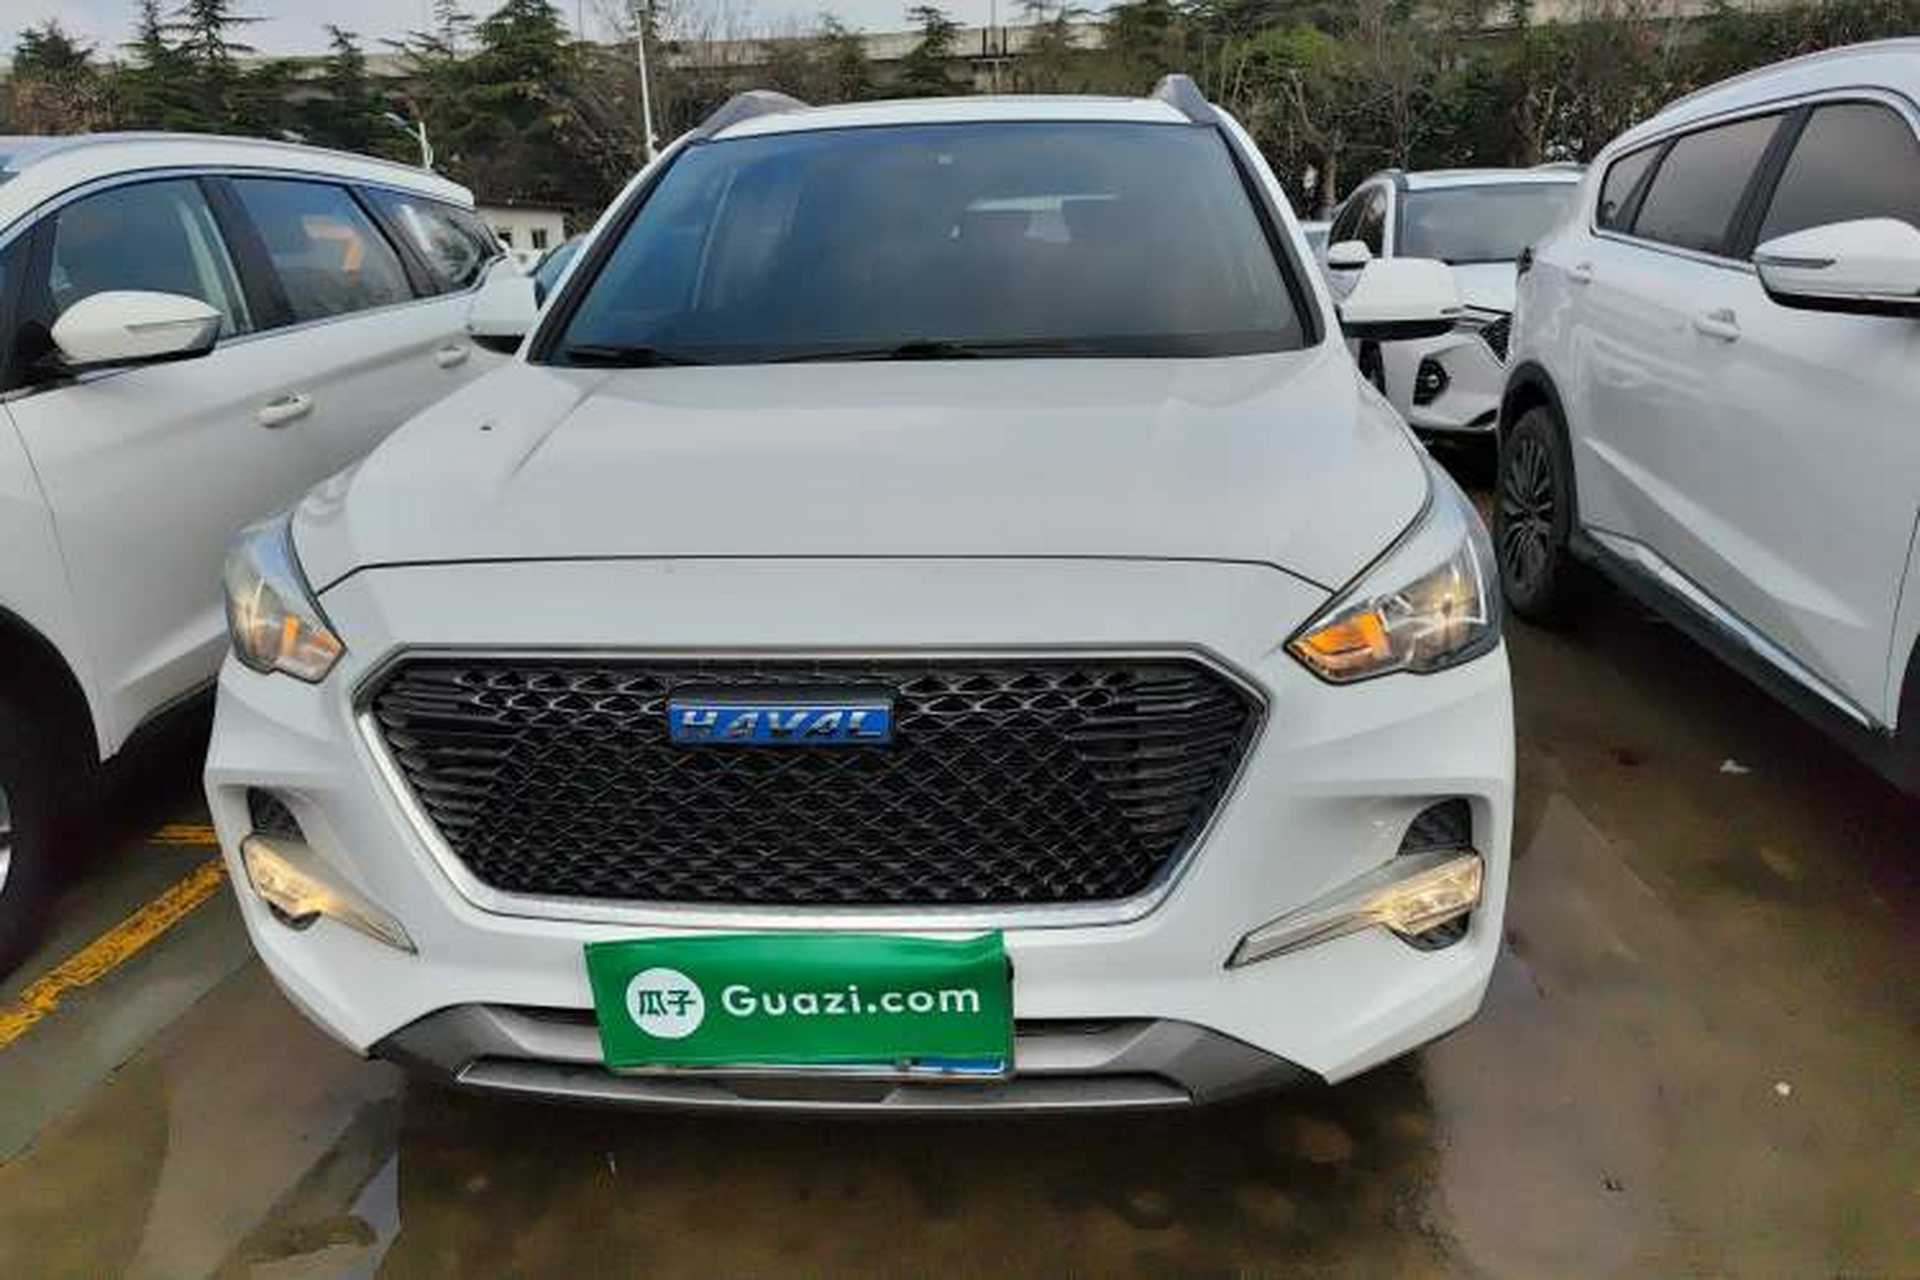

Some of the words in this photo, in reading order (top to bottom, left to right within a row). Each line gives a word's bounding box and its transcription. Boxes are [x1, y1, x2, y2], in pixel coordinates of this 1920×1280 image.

[682, 711, 883, 737] HAVAL
[638, 989, 696, 1017] 瓜子
[721, 985, 981, 1017] Guazi.com
